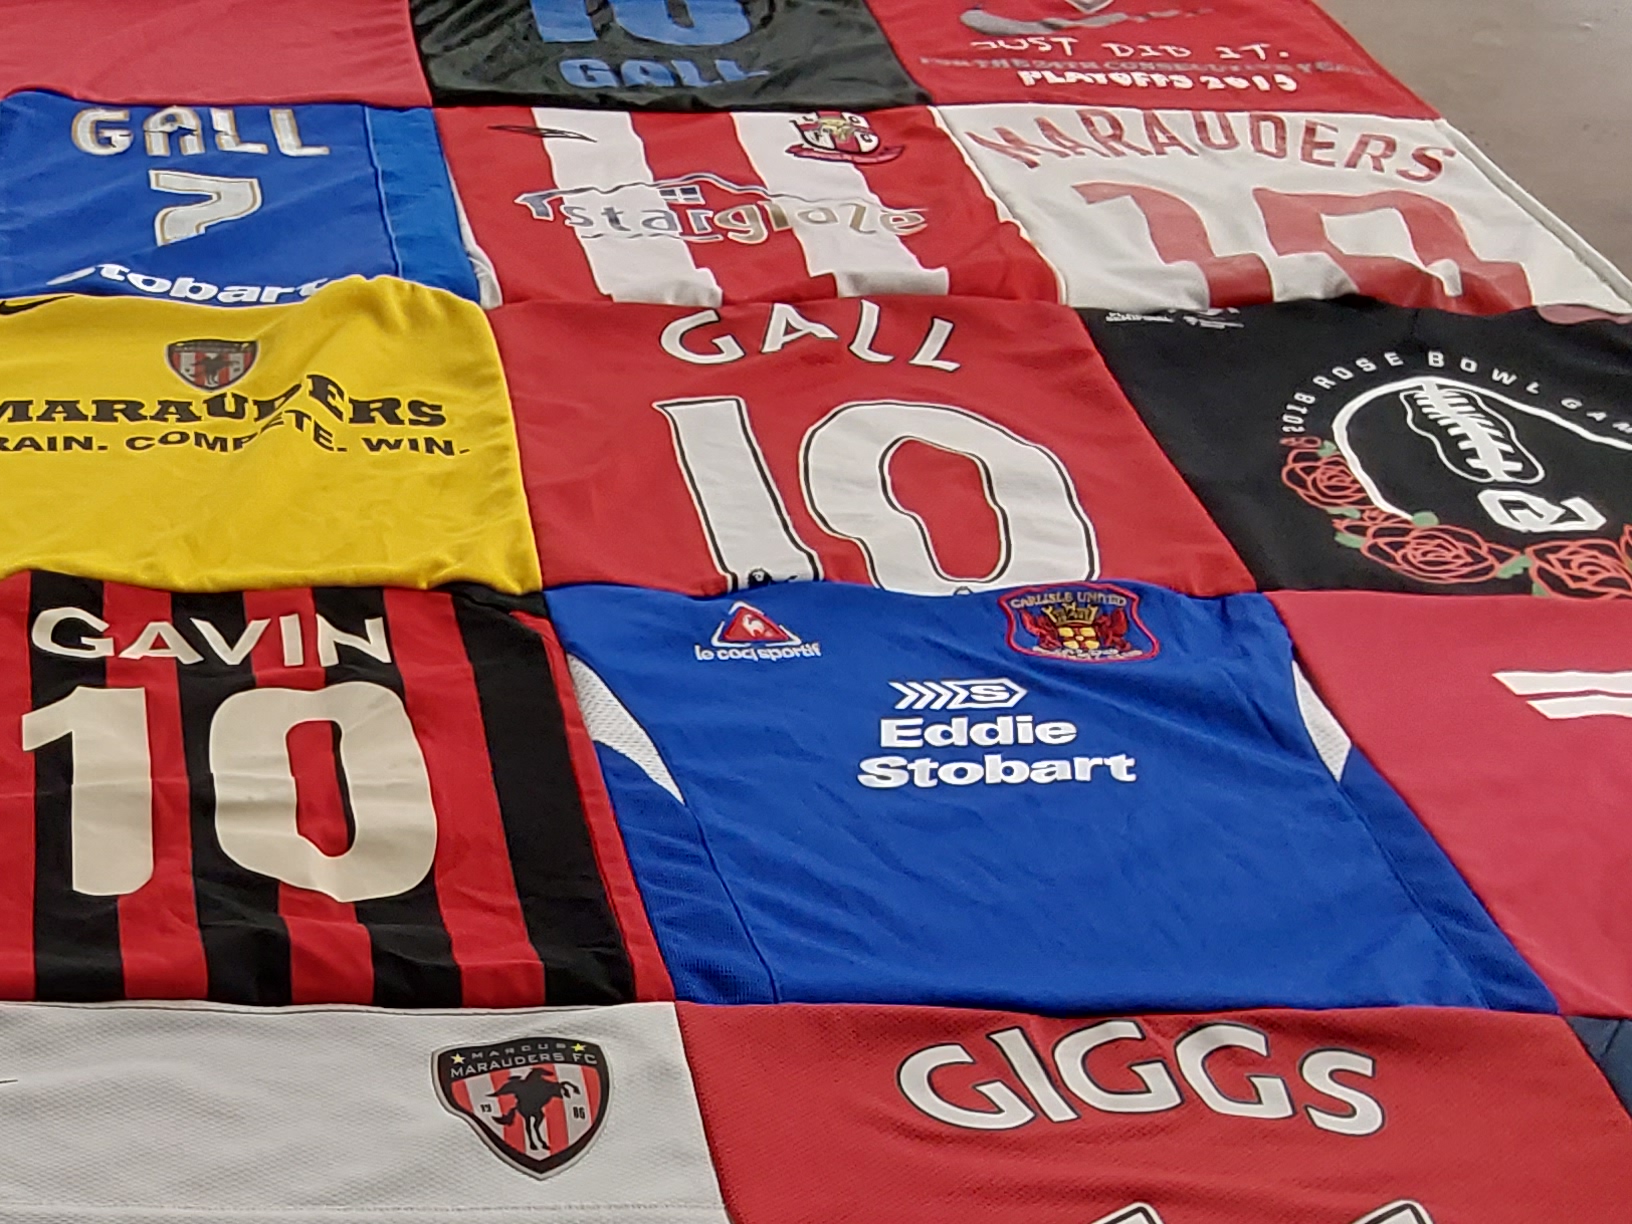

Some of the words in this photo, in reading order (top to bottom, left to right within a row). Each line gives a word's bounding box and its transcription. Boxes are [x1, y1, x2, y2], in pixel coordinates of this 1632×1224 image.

[559, 58, 769, 88] GALL
[1101, 42, 1191, 57] DID
[1018, 70, 1194, 89] PLAYOFFS
[72, 106, 330, 156] GALL
[968, 108, 1456, 182] MARAUDERS
[149, 169, 262, 247] 7
[659, 299, 961, 372] GALL
[1312, 351, 1404, 390] ROSE
[1427, 350, 1542, 395] BOWL
[363, 437, 471, 457] WIN.
[651, 396, 1101, 595] 10
[31, 607, 392, 667] GAVIN
[880, 715, 1077, 748] Eddie
[22, 681, 438, 903] 10
[857, 753, 1137, 788] Stobart
[450, 1051, 565, 1078] MARAUDERS
[572, 1052, 598, 1065] FC
[897, 1018, 1386, 1135] GIGGS
